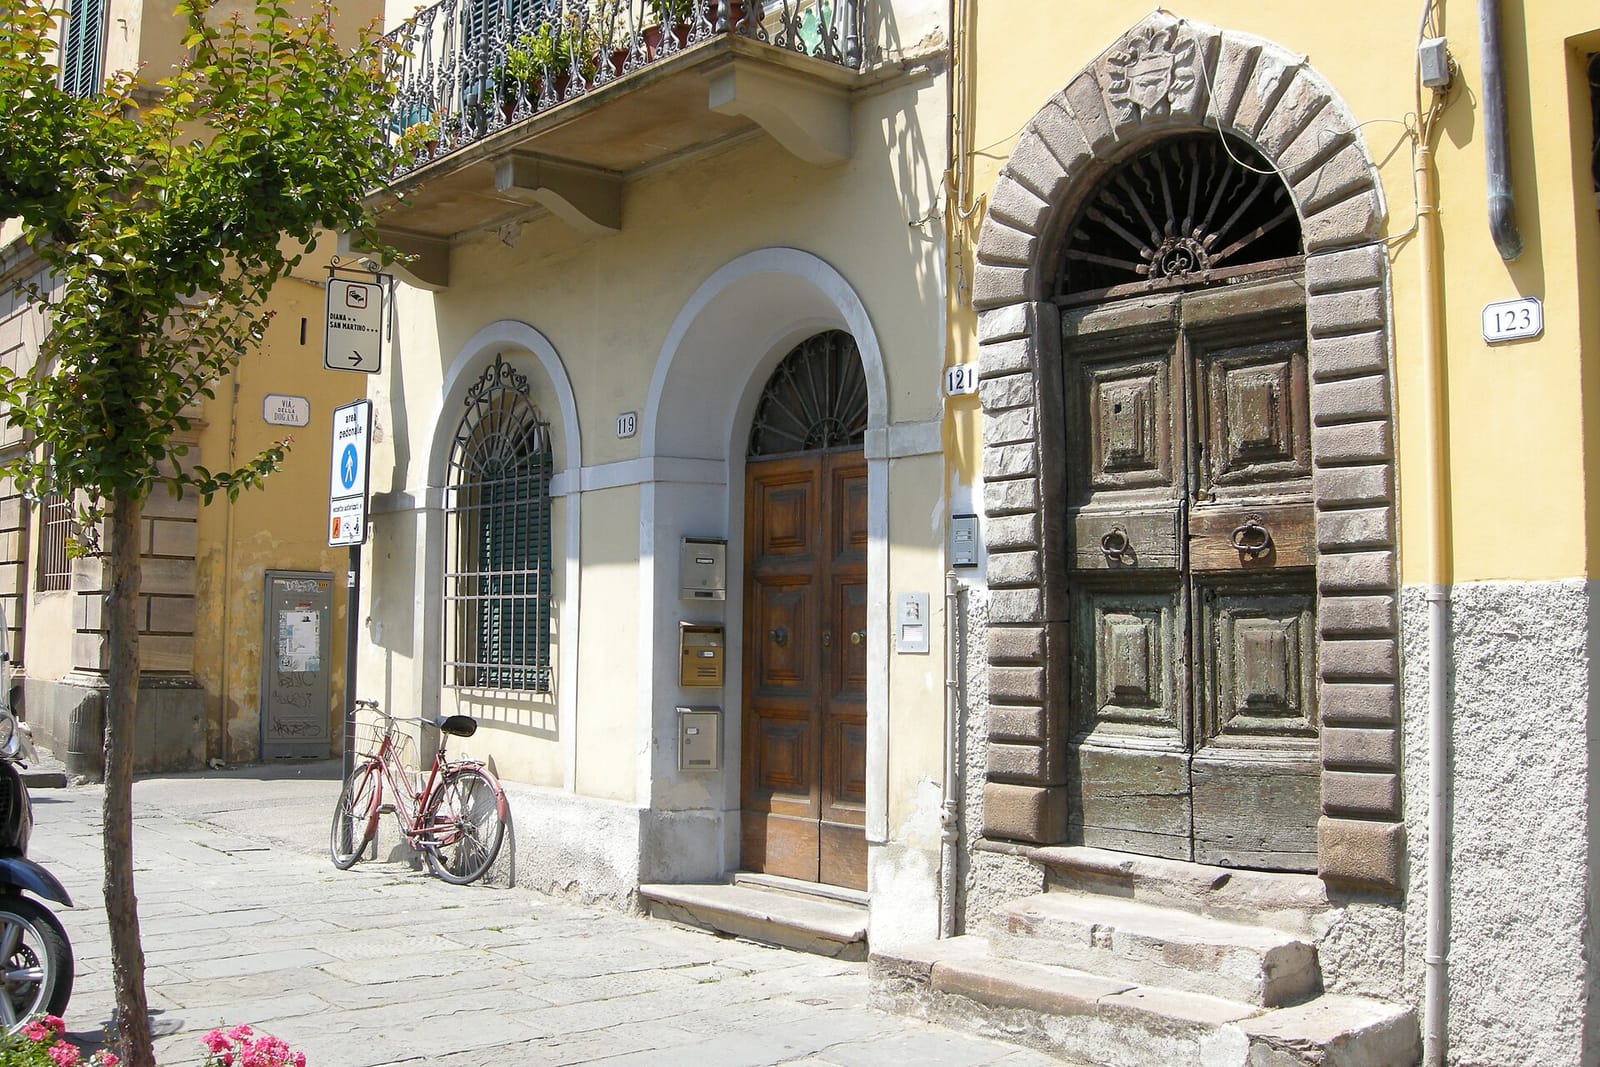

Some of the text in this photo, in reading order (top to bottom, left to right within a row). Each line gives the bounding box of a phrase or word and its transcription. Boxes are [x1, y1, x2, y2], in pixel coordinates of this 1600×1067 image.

[330, 313, 346, 321] DIANA
[1496, 308, 1531, 333] 123
[330, 321, 366, 332] SAN MARTINO
[949, 369, 972, 392] 121
[281, 399, 293, 409] VIA
[273, 412, 299, 422] DOGANA
[345, 413, 357, 423] area
[618, 416, 634, 434] 119
[339, 425, 363, 440] pedonale
